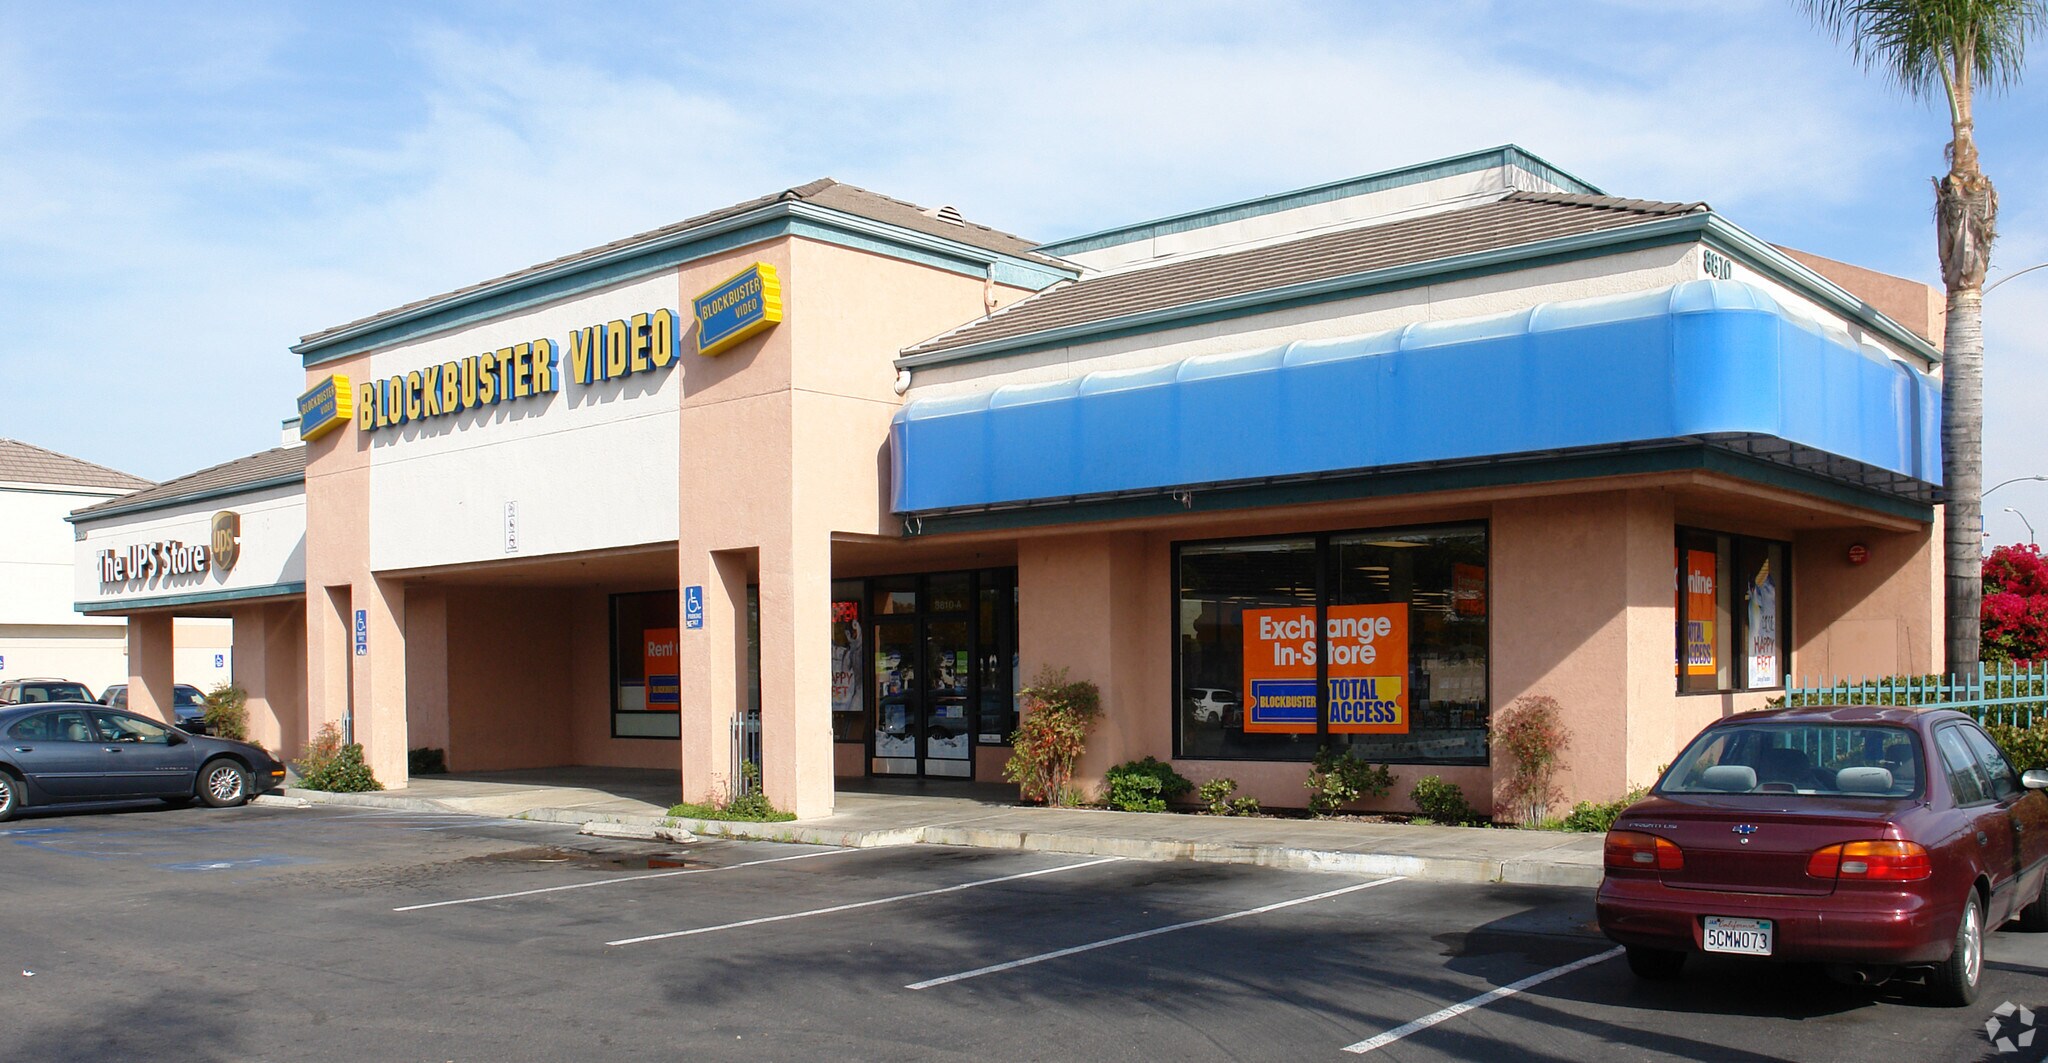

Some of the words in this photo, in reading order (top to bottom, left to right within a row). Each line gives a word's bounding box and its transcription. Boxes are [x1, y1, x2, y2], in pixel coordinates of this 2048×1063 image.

[1703, 249, 1731, 280] 8810
[702, 277, 761, 321] BLOCKBUSTER
[735, 298, 757, 319] VIDEO
[360, 338, 556, 431] BLOCKBUSTER
[569, 308, 678, 385] VIDEO
[213, 528, 233, 562] ups
[98, 550, 123, 583] The
[127, 542, 157, 580] UPS
[162, 540, 205, 574] Store
[832, 601, 858, 622] OPEN
[1259, 614, 1391, 644] Exchange
[1687, 622, 1705, 642] OTAL
[648, 641, 673, 657] Rent
[1274, 641, 1377, 666] In-Store
[1687, 643, 1711, 665] CCESS
[832, 671, 853, 685] APPY
[832, 685, 849, 698] EET
[1329, 679, 1378, 700] TOTAL
[1260, 695, 1317, 708] BLOCKBUSTER
[1329, 700, 1396, 723] ACCESS
[1708, 929, 1768, 949] 5CMW073
